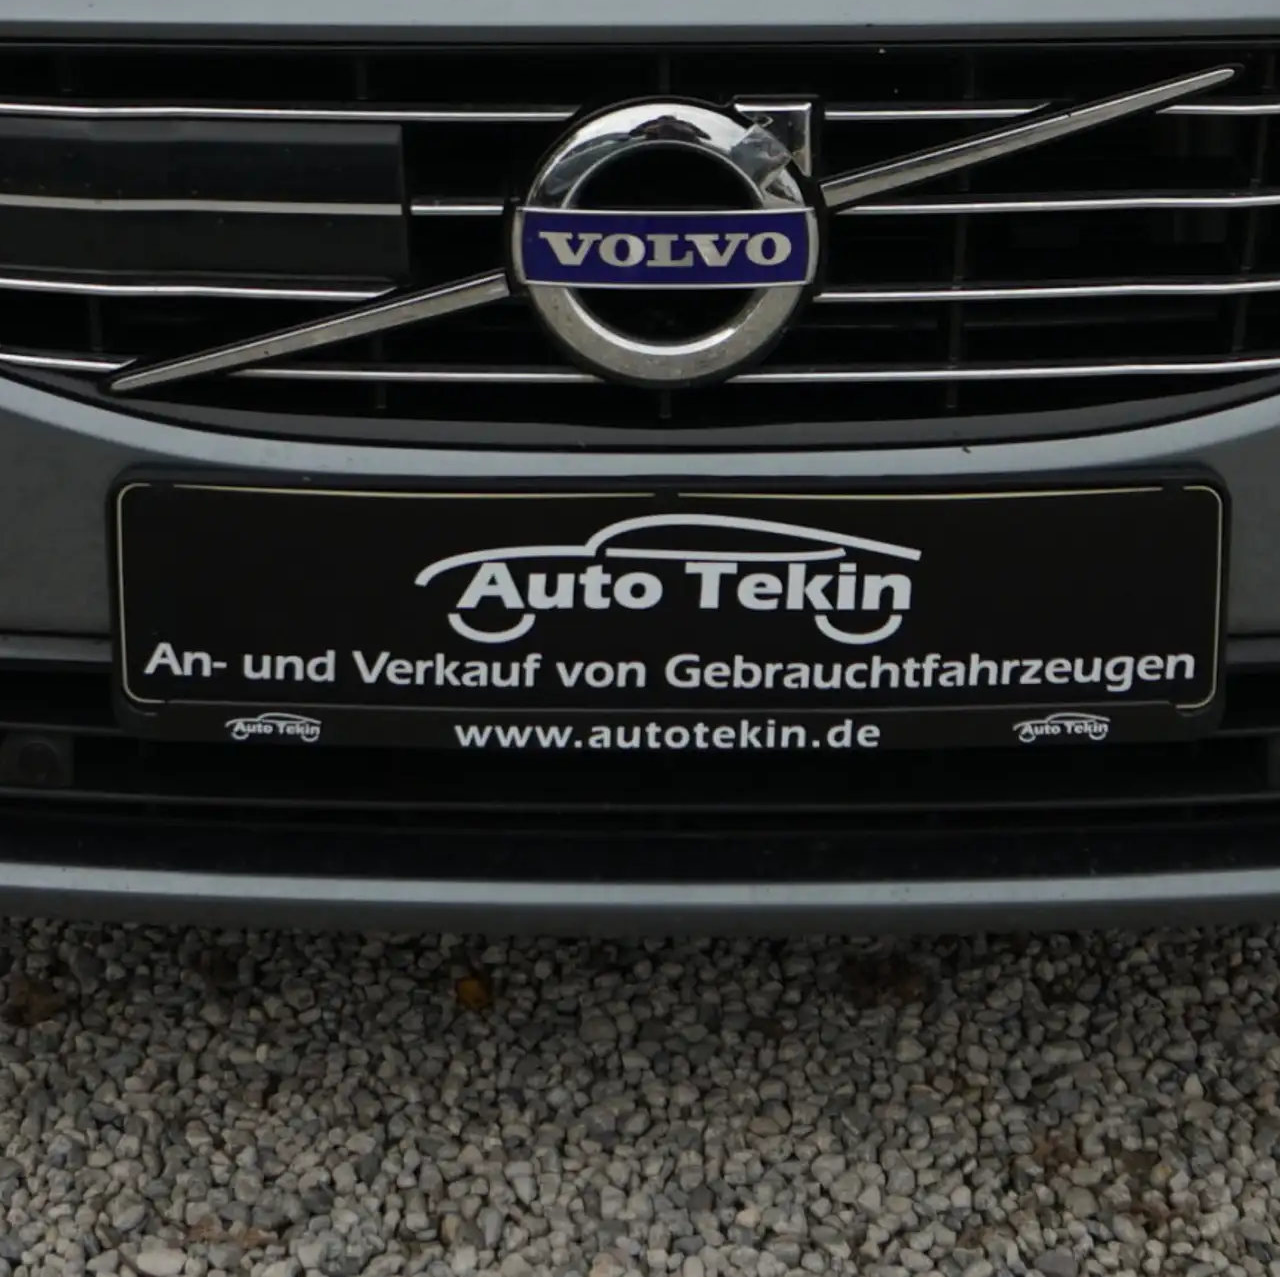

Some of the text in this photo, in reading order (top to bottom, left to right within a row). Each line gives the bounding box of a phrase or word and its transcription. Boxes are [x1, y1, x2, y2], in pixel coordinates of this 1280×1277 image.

[538, 231, 792, 267] VOLVO
[456, 561, 913, 611] Auto Tekin
[144, 642, 1196, 692] An- und Verkauf von Gebrauchtfahrzeugen
[233, 721, 321, 736] Auto Tekin
[454, 719, 881, 749] www.autotekin.de
[1020, 721, 1109, 736] Auto Tekin
